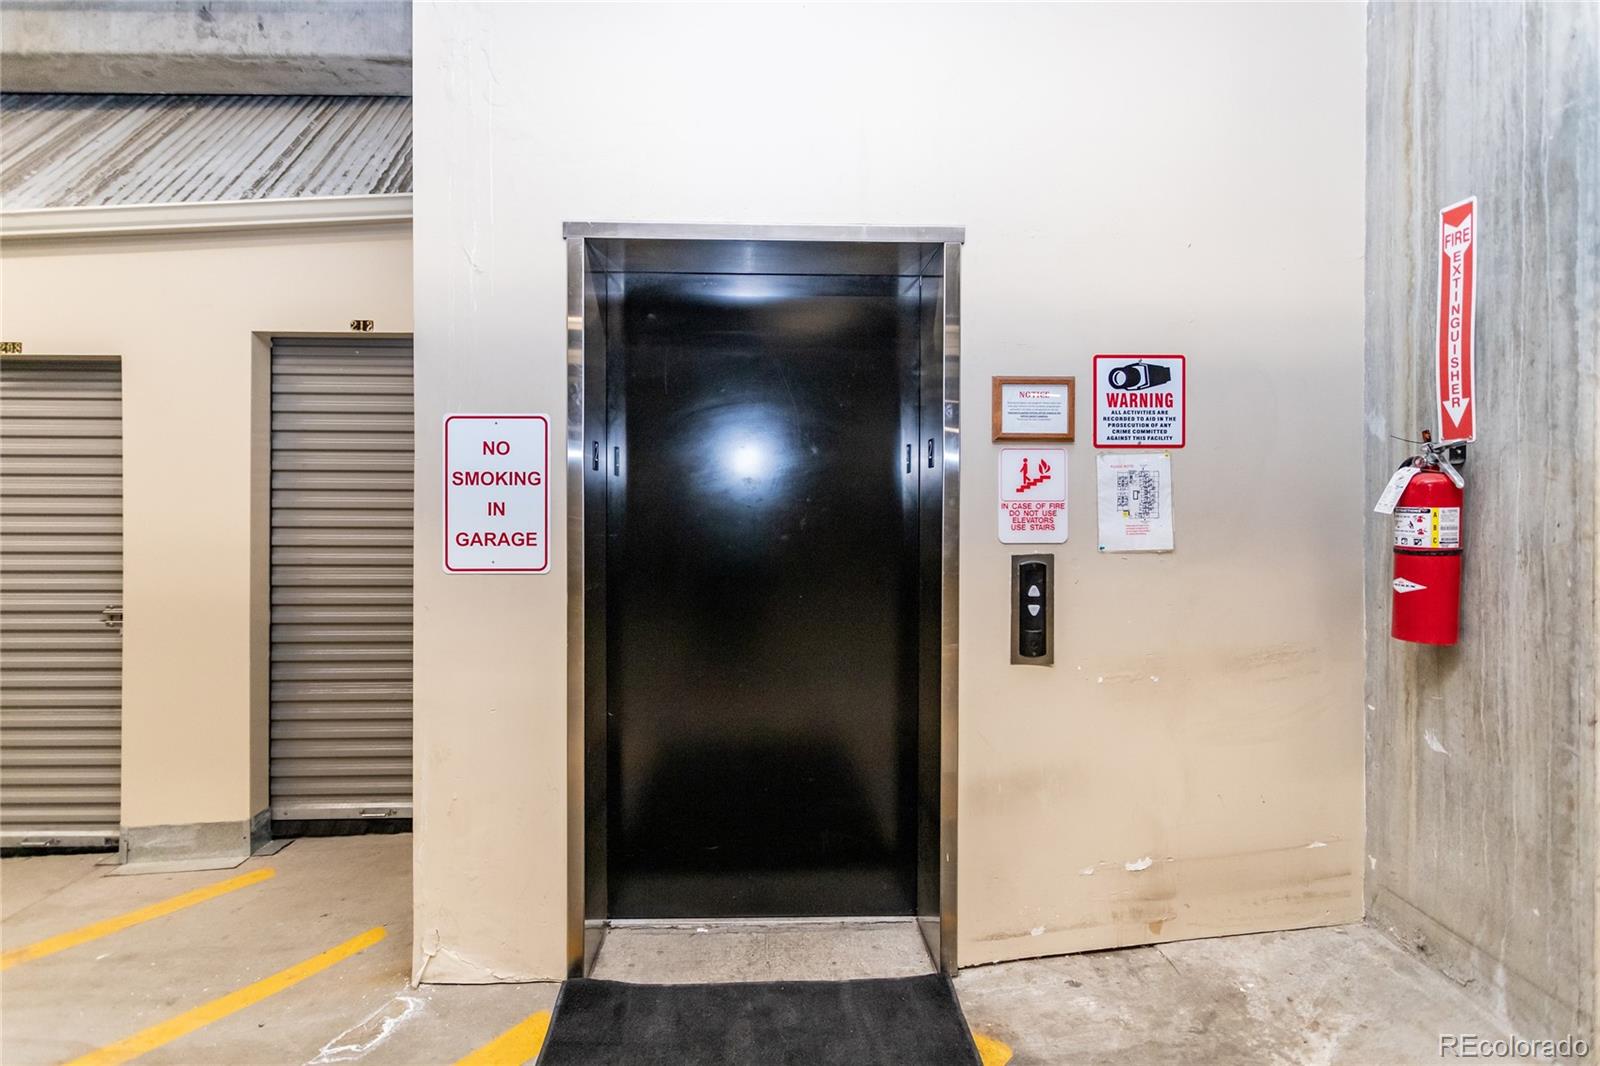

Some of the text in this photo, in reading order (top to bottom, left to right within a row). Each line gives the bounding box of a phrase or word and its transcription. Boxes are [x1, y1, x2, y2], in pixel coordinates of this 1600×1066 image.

[1445, 227, 1470, 249] FIRE
[351, 320, 374, 332] 212
[1450, 251, 1461, 408] EXTINGUISHER
[1106, 393, 1174, 408] WARNING
[482, 441, 511, 455] NO
[452, 471, 541, 486] SMOKING
[487, 502, 505, 516] IN
[455, 532, 538, 547] GARAGE
